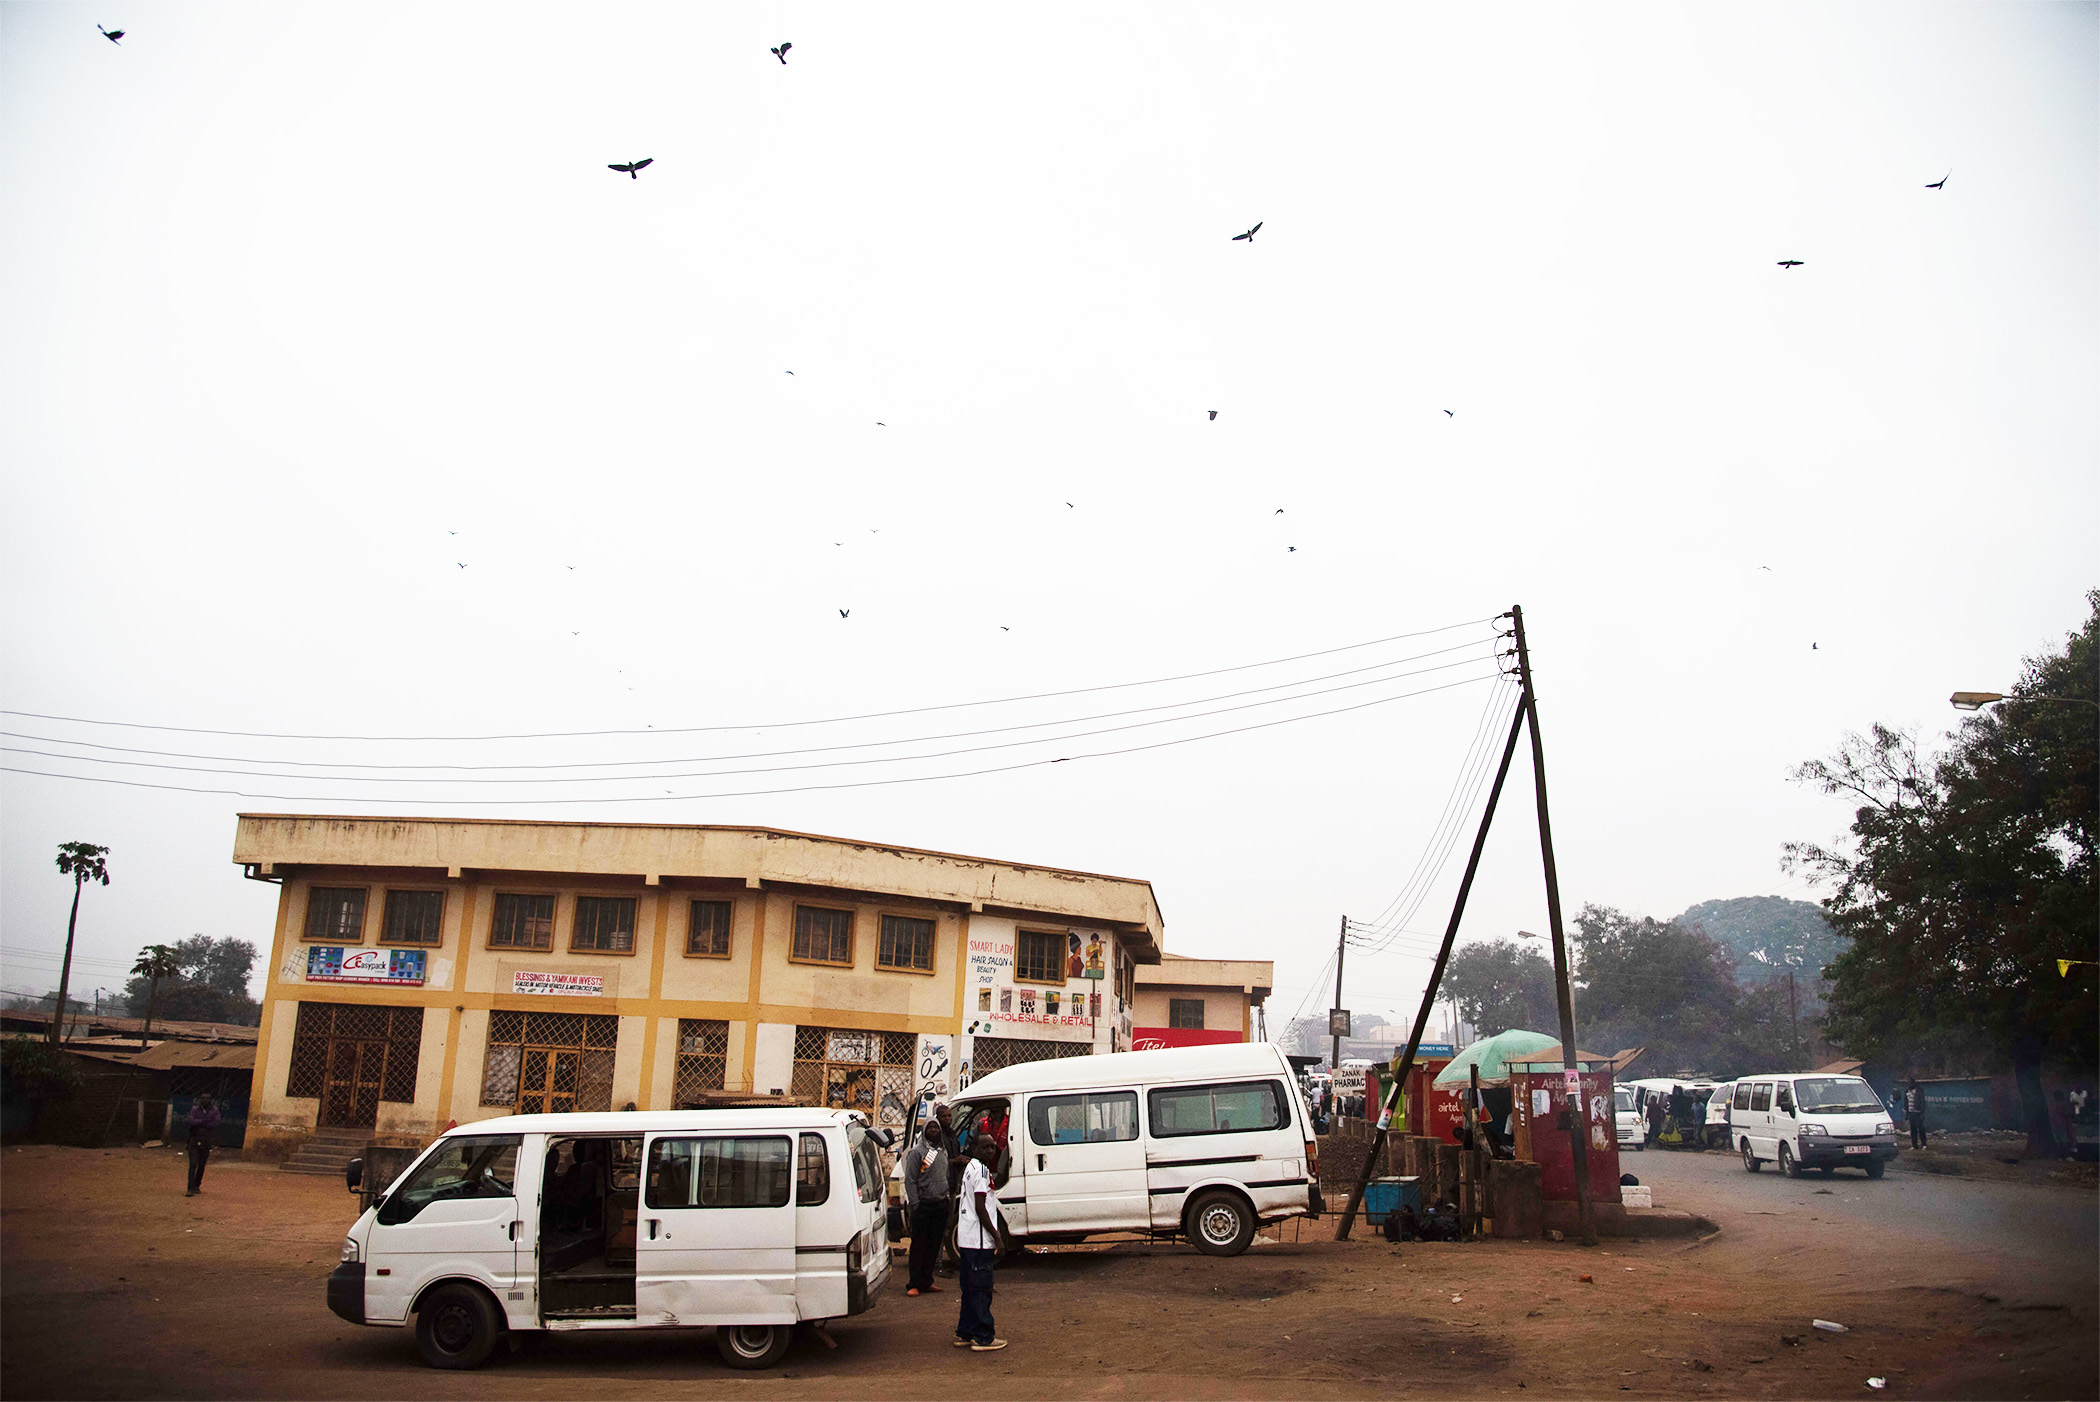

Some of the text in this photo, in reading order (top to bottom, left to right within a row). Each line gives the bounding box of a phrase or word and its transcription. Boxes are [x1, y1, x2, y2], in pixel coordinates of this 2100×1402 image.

[969, 940, 1014, 956] SMART LADY
[970, 955, 988, 966] HAIR
[987, 956, 1009, 967] SALON
[976, 965, 997, 975] BEAUTY
[546, 974, 551, 982] &
[978, 975, 994, 984] SHOP
[989, 1011, 1093, 1027] WHOLESALE & RETAIL
[1142, 1040, 1166, 1050] itel
[1334, 1077, 1366, 1088] PHARMAC
[1541, 1077, 1567, 1090] Airtel
[1438, 1101, 1460, 1112] airtel
